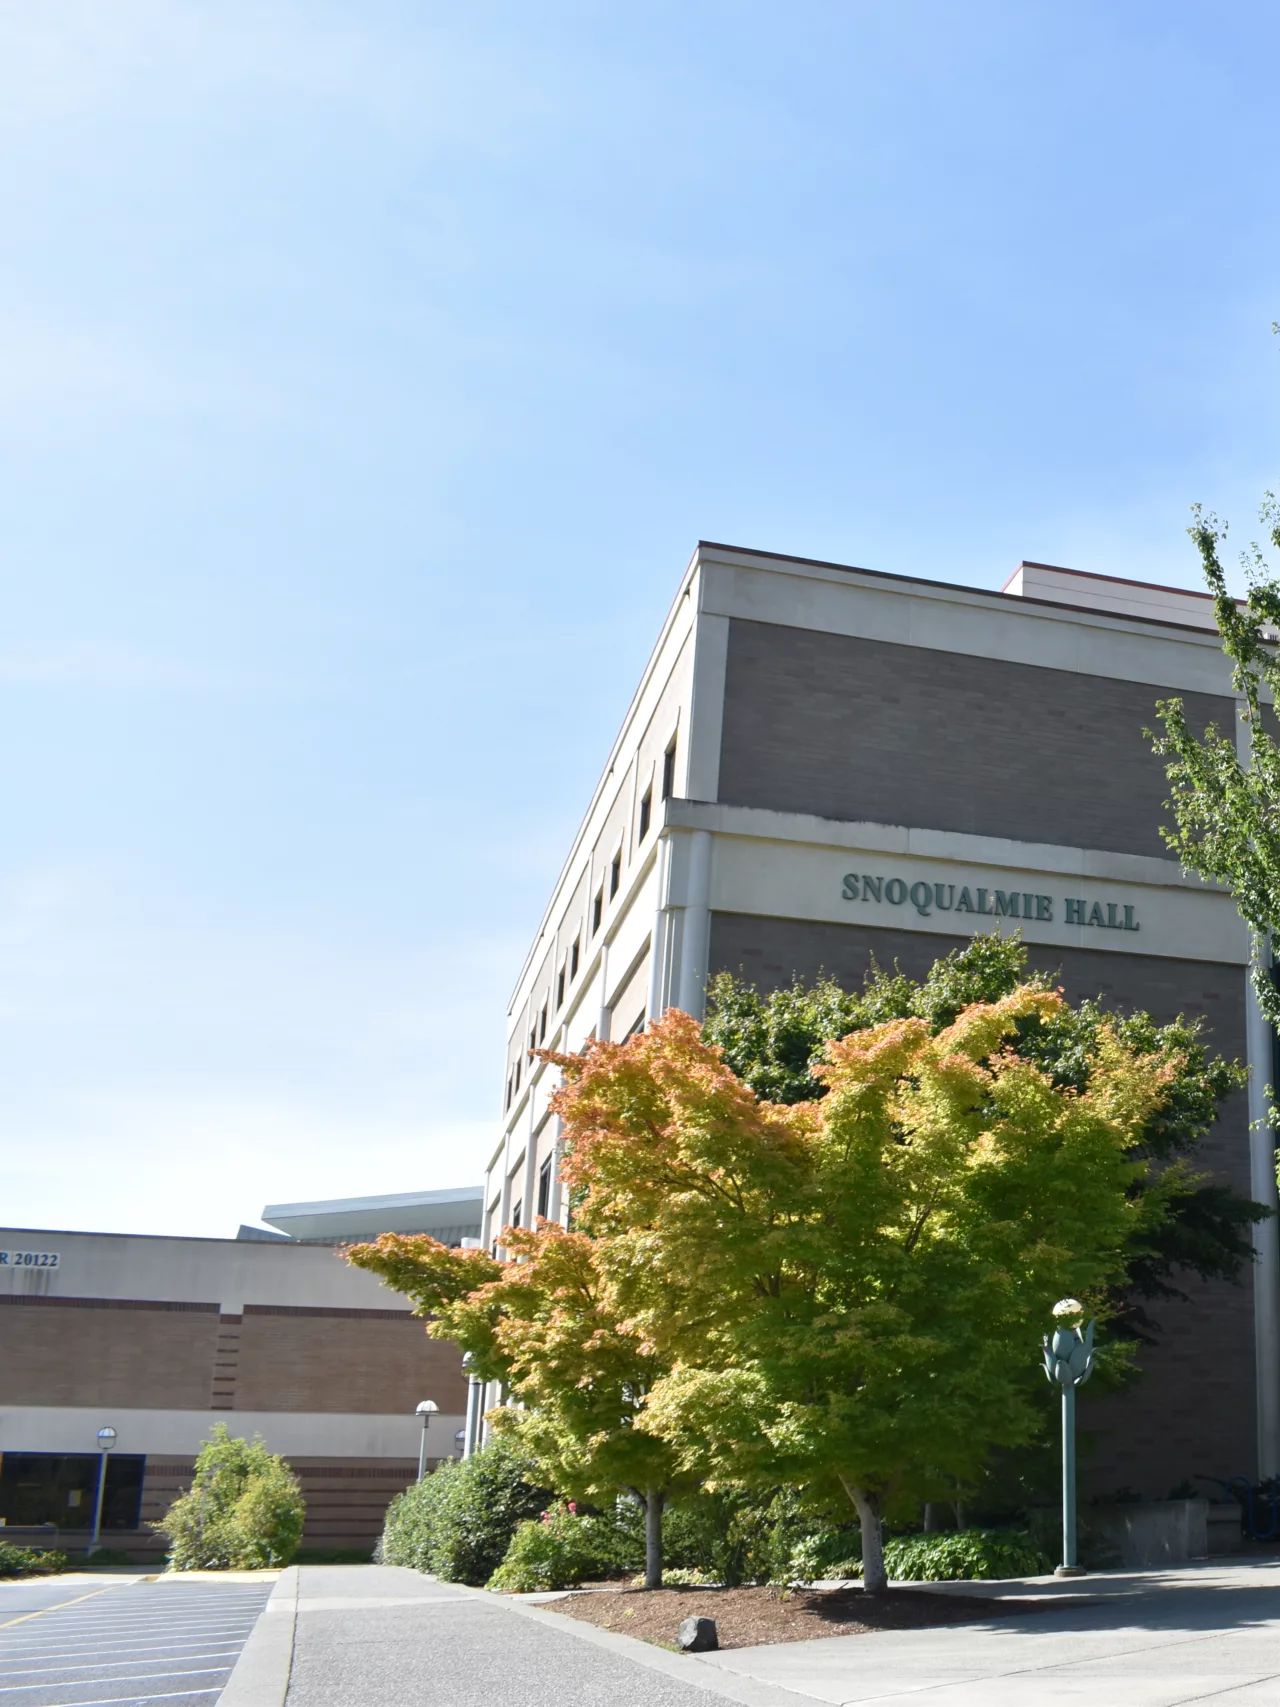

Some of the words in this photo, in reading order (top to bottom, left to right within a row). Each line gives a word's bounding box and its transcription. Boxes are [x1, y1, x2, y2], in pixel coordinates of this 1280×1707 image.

[840, 872, 1053, 922] SNOQUALMIE
[1064, 897, 1140, 931] HALL
[14, 1253, 58, 1267] 20122
